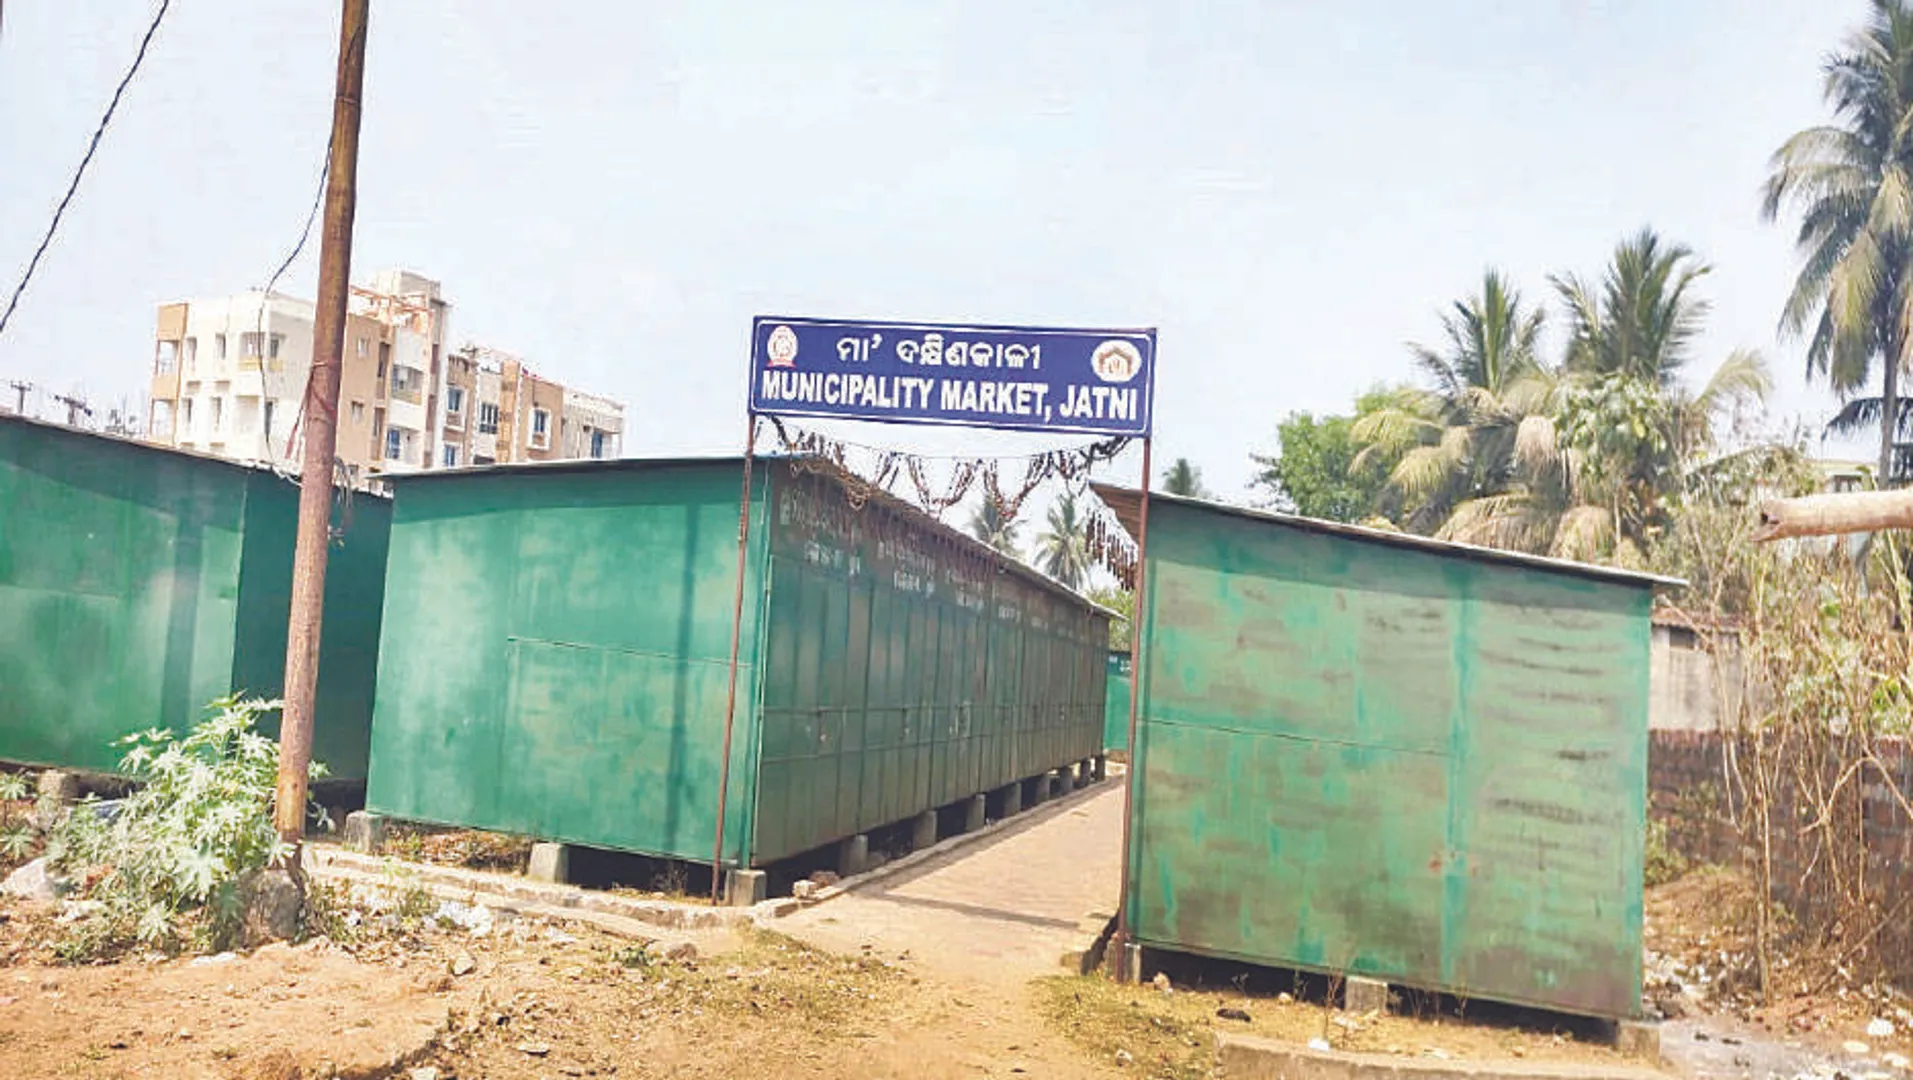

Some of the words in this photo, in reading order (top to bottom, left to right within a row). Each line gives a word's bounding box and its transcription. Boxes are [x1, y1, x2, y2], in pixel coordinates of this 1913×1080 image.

[762, 370, 934, 410] MUNICIPALITY
[940, 379, 1053, 423] MARKET,
[1059, 384, 1138, 421] JATNI
